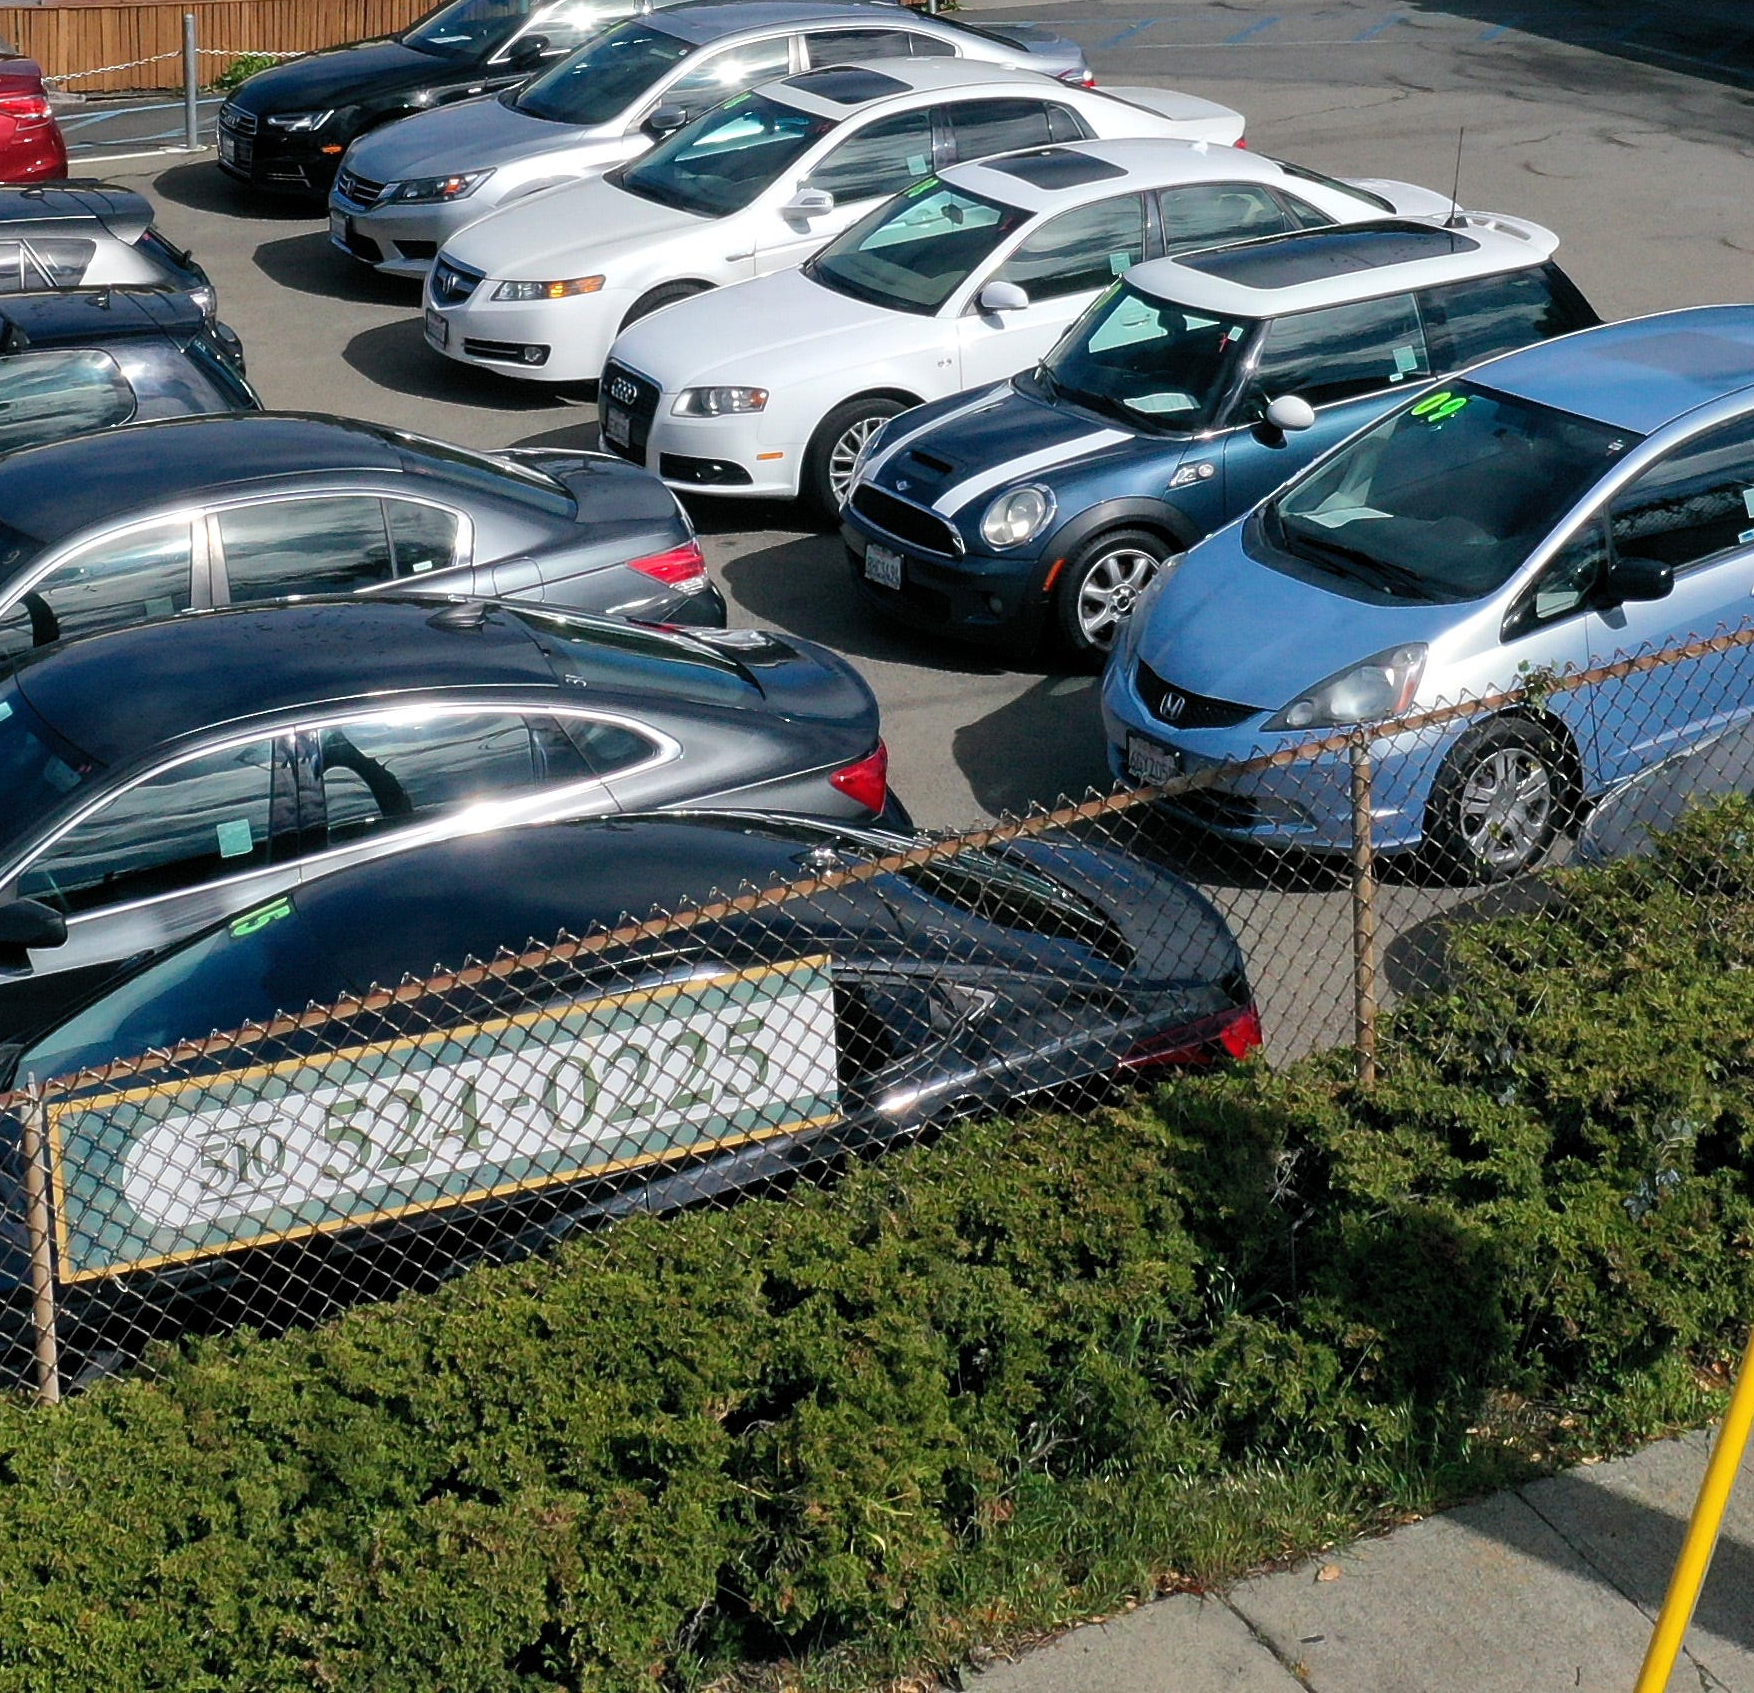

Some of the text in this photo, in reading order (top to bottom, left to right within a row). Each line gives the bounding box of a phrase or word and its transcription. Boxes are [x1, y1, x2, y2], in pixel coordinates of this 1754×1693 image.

[1410, 391, 1468, 423] 09
[198, 1018, 771, 1190] 510 524-0225
